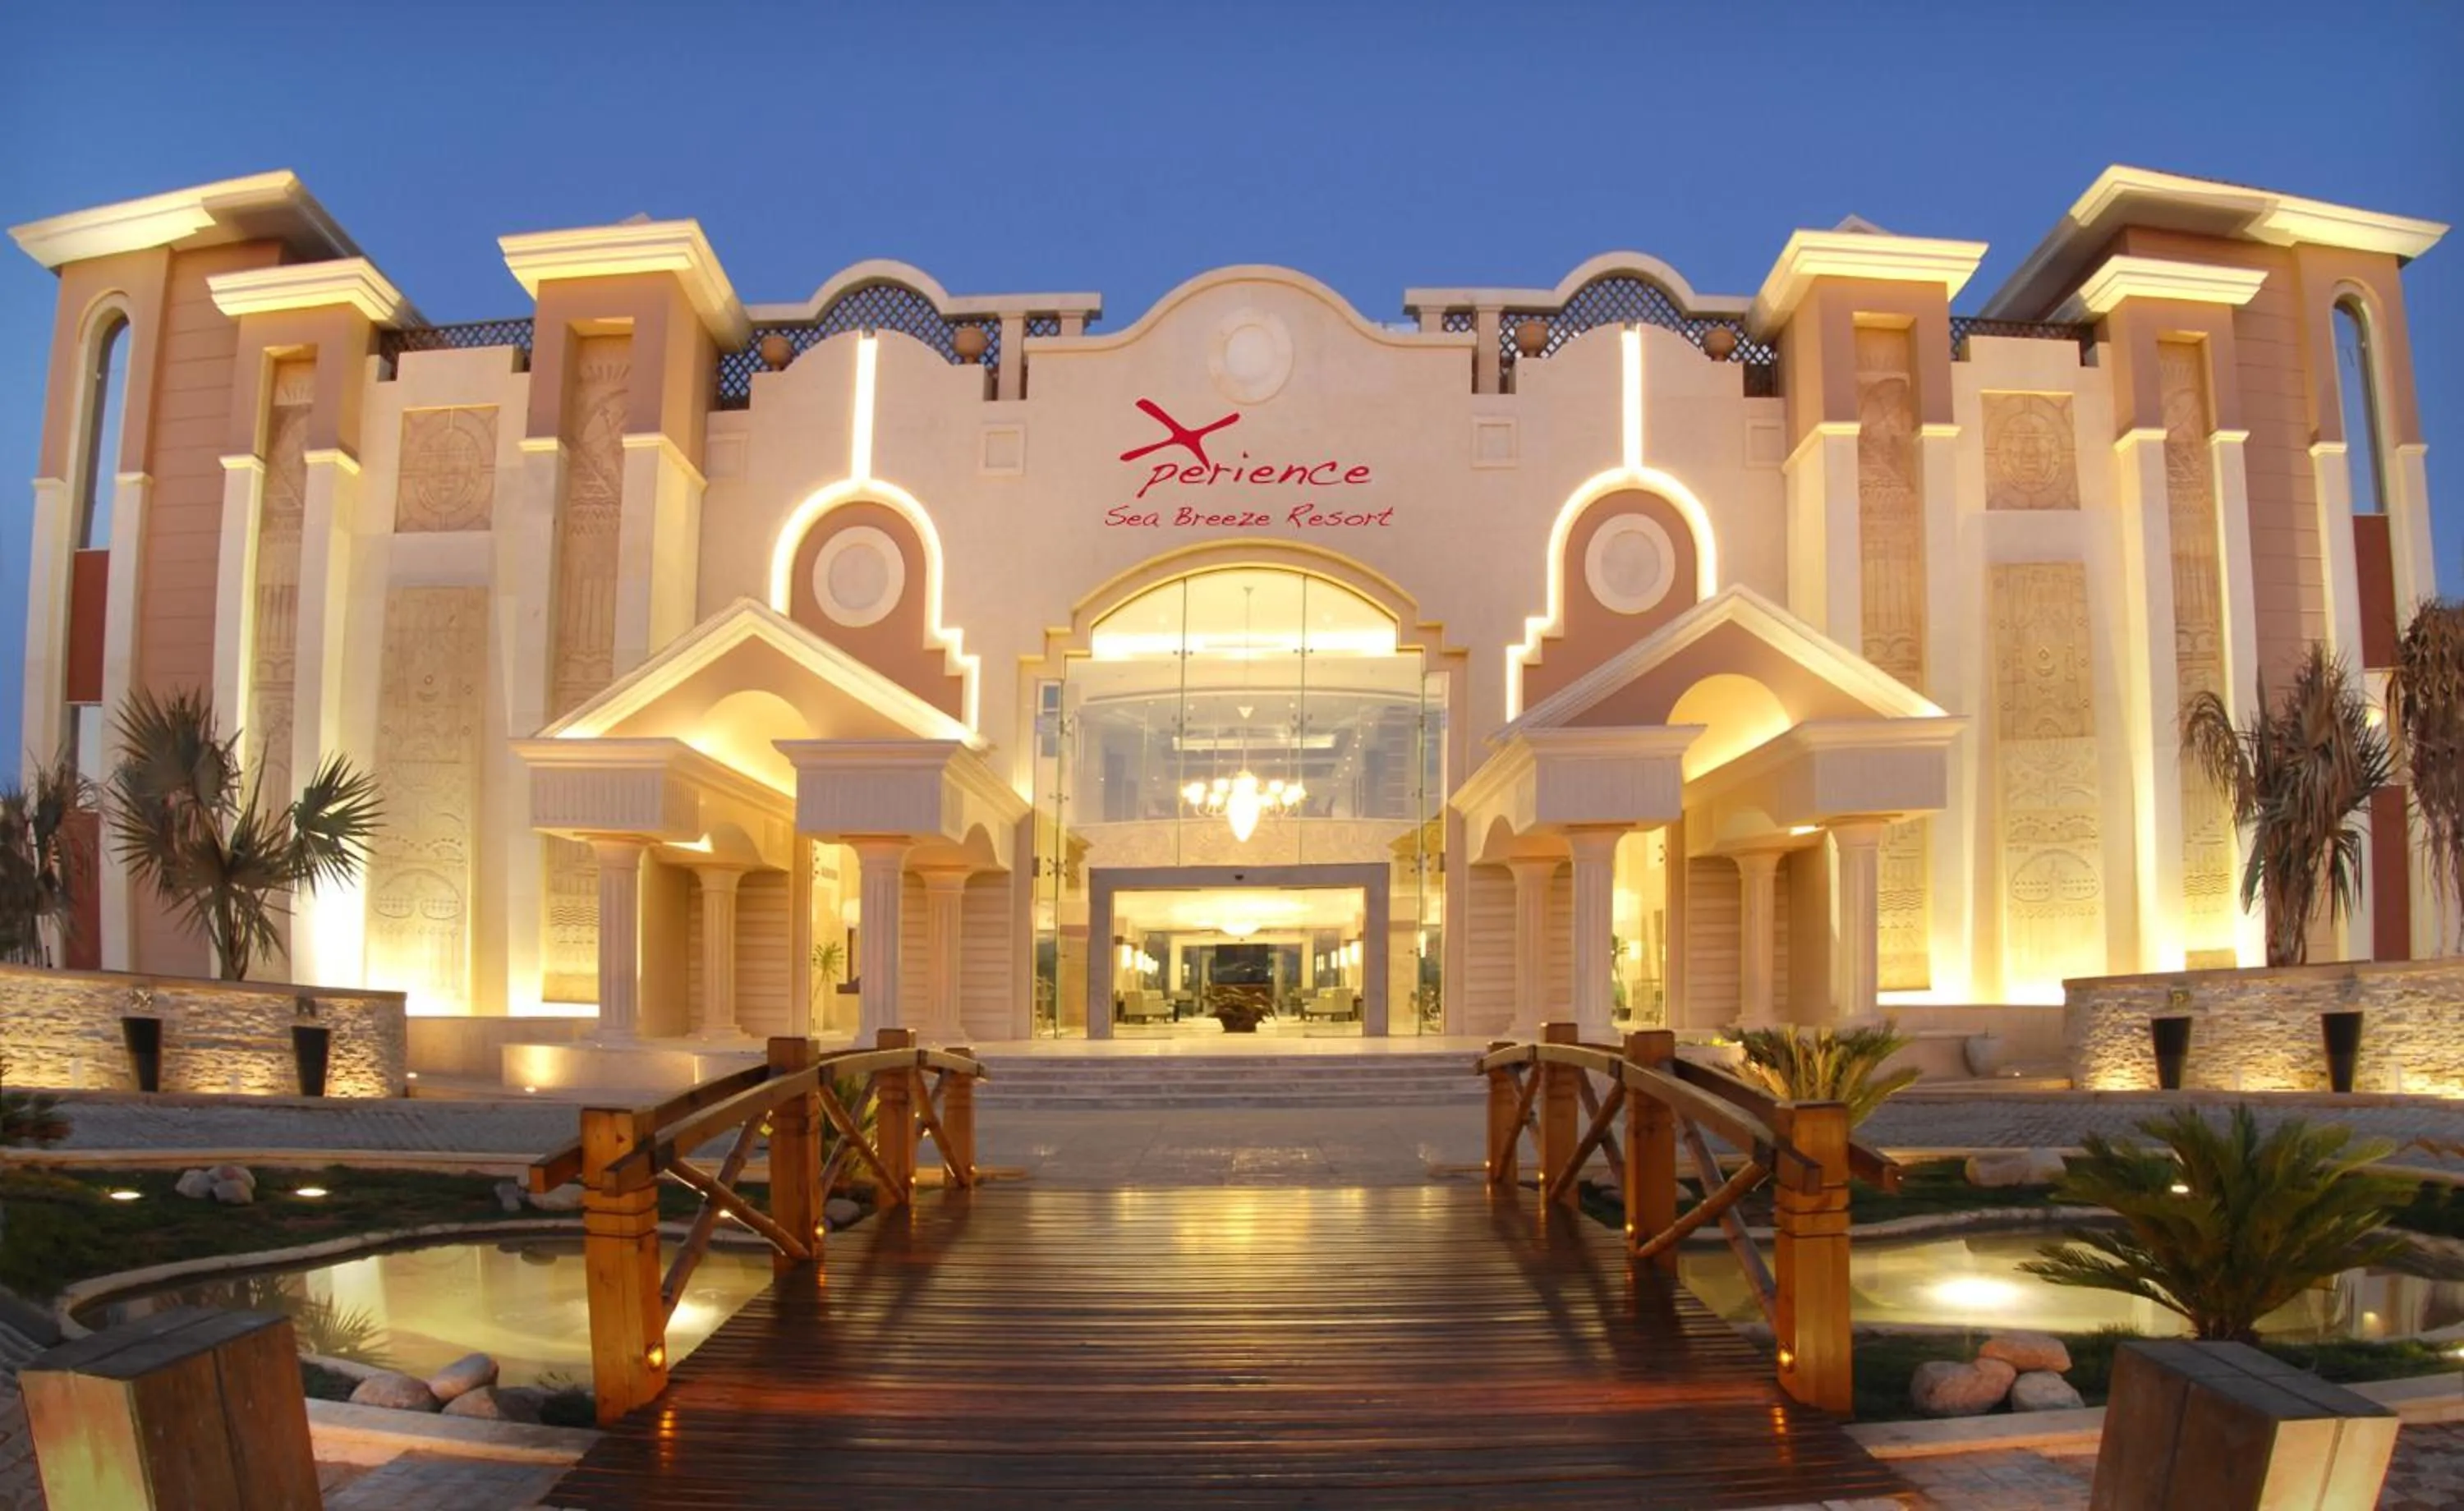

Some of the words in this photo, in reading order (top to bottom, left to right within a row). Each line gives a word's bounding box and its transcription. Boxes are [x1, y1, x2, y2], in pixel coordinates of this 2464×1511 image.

[1104, 504, 1160, 528] Sea
[1173, 506, 1271, 528] Breeze
[1287, 503, 1394, 528] Resort
